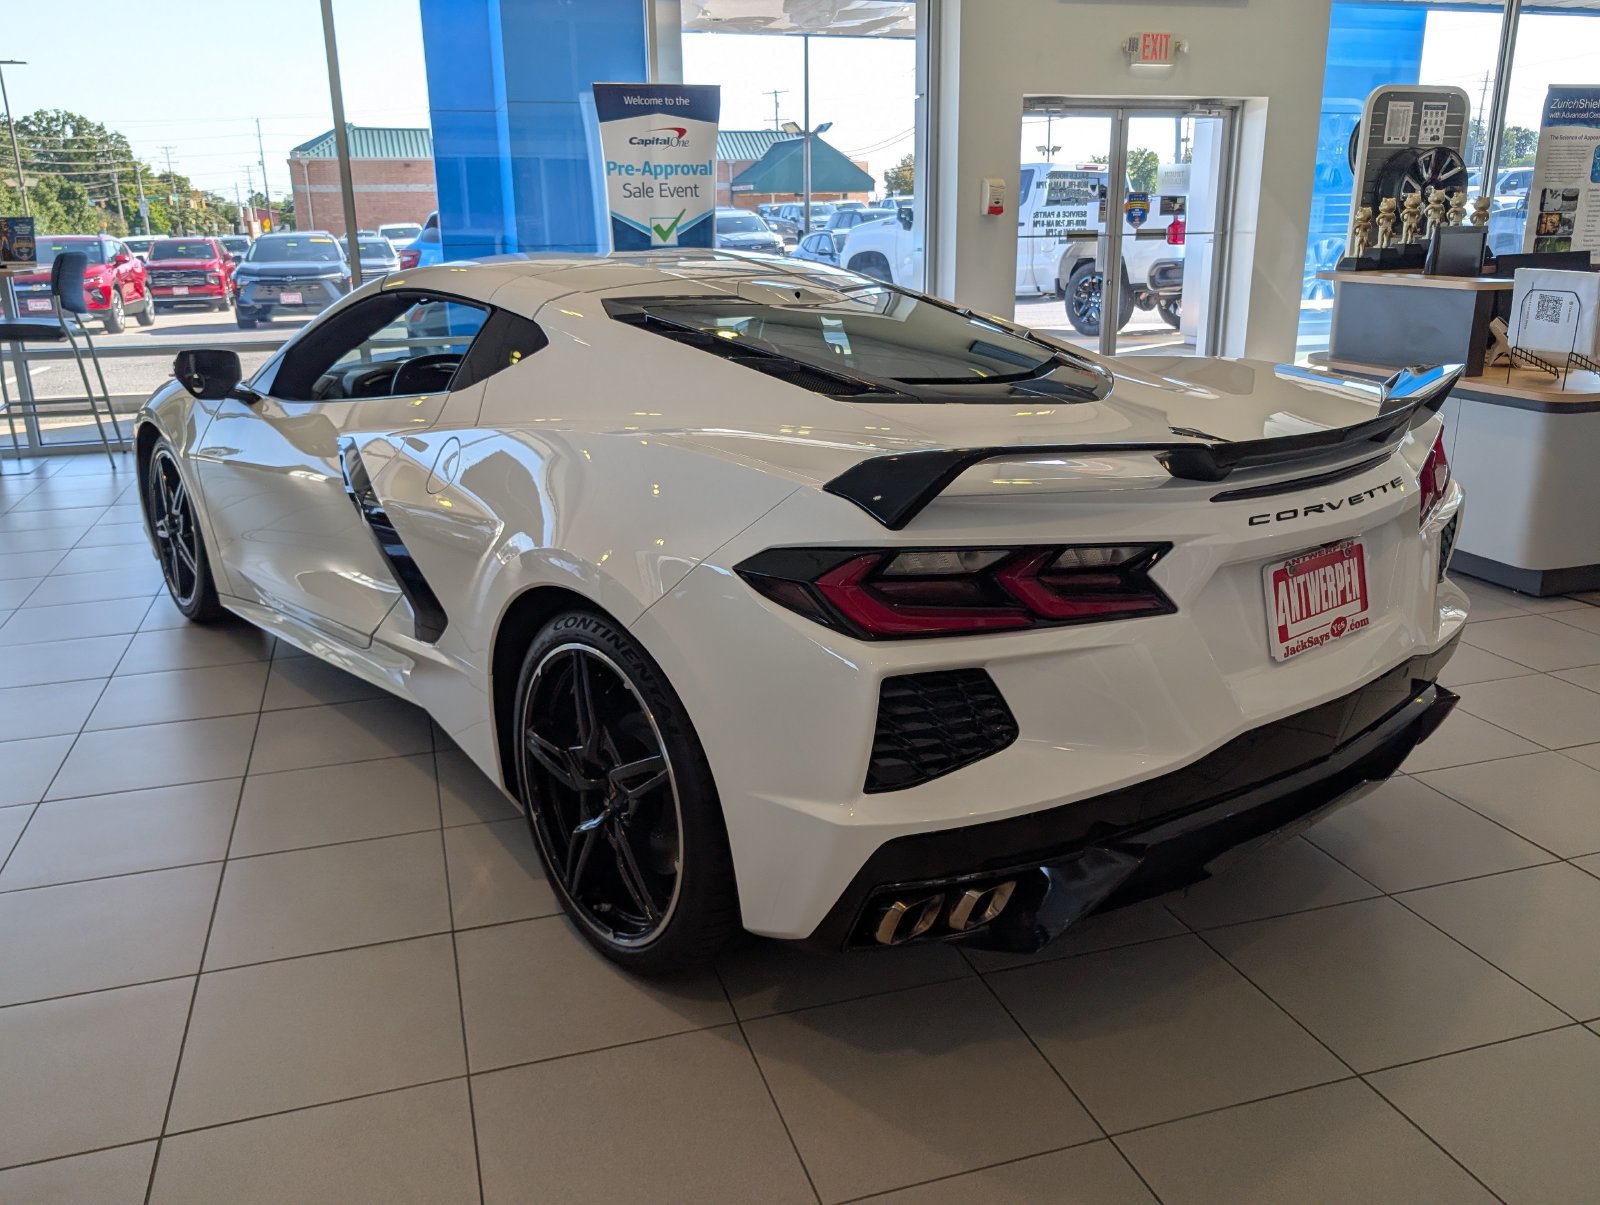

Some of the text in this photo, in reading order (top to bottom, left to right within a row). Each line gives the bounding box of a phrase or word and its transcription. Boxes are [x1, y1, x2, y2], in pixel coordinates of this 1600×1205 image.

[1141, 33, 1171, 60] EXIT
[623, 96, 690, 106] Welcome to the
[606, 160, 713, 181] Pre-Approval
[622, 182, 700, 199] Sale Event
[1248, 475, 1404, 526] CORVETTE
[1277, 556, 1361, 627] ANTWERPEN
[552, 615, 682, 735] CONTINENTA
